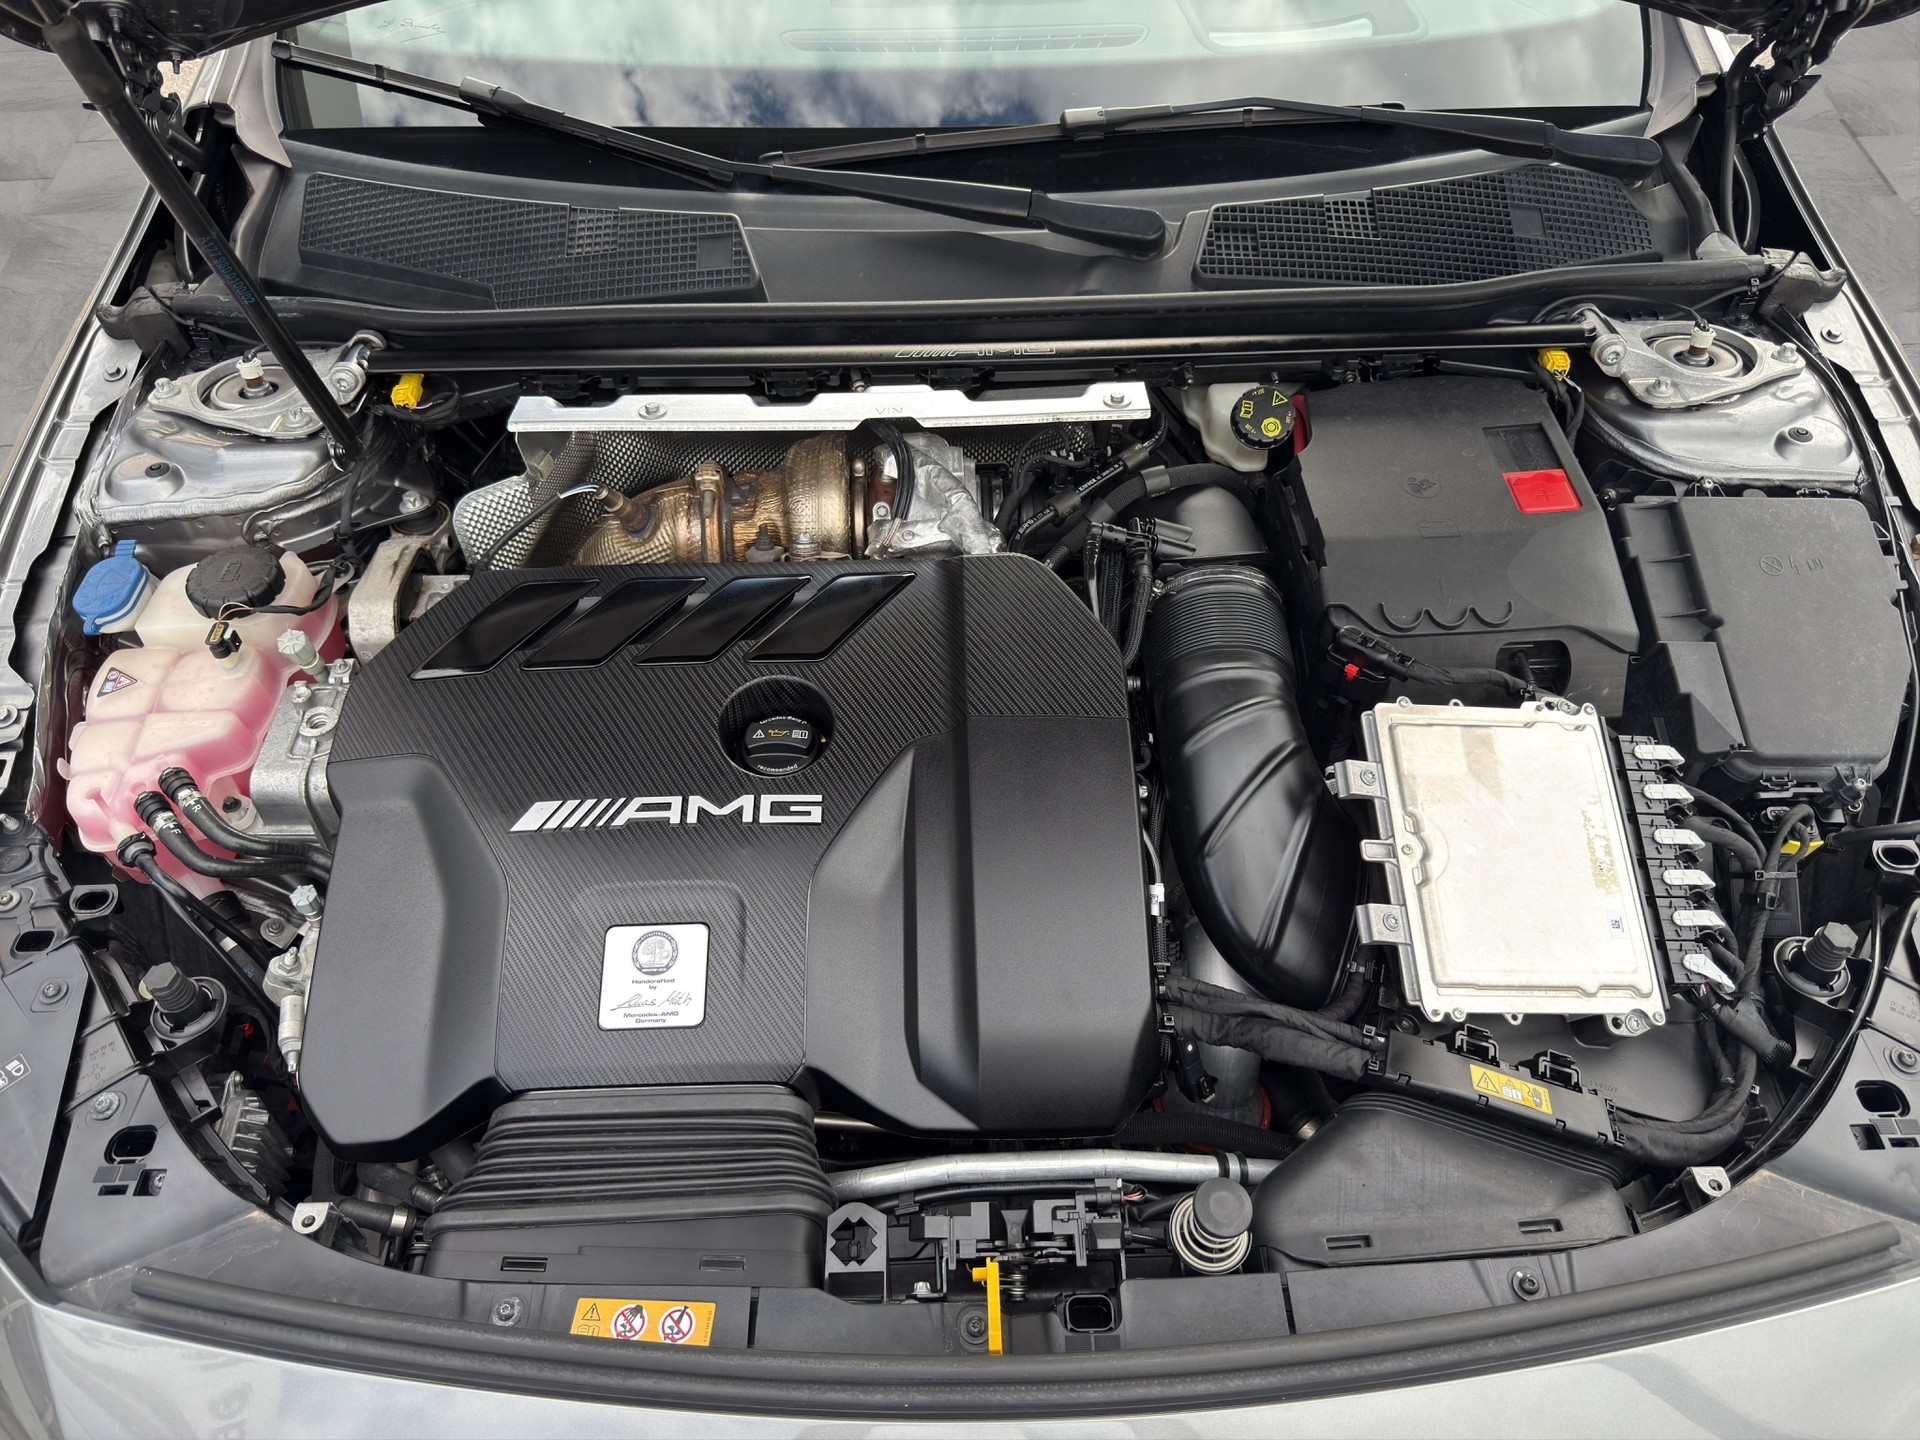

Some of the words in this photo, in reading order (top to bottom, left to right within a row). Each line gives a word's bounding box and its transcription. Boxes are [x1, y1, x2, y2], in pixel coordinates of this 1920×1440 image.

[874, 406, 904, 416] VIN
[756, 763, 798, 773] recommended
[609, 795, 823, 827] AMG
[623, 1010, 680, 1018] Mercedes-AMG
